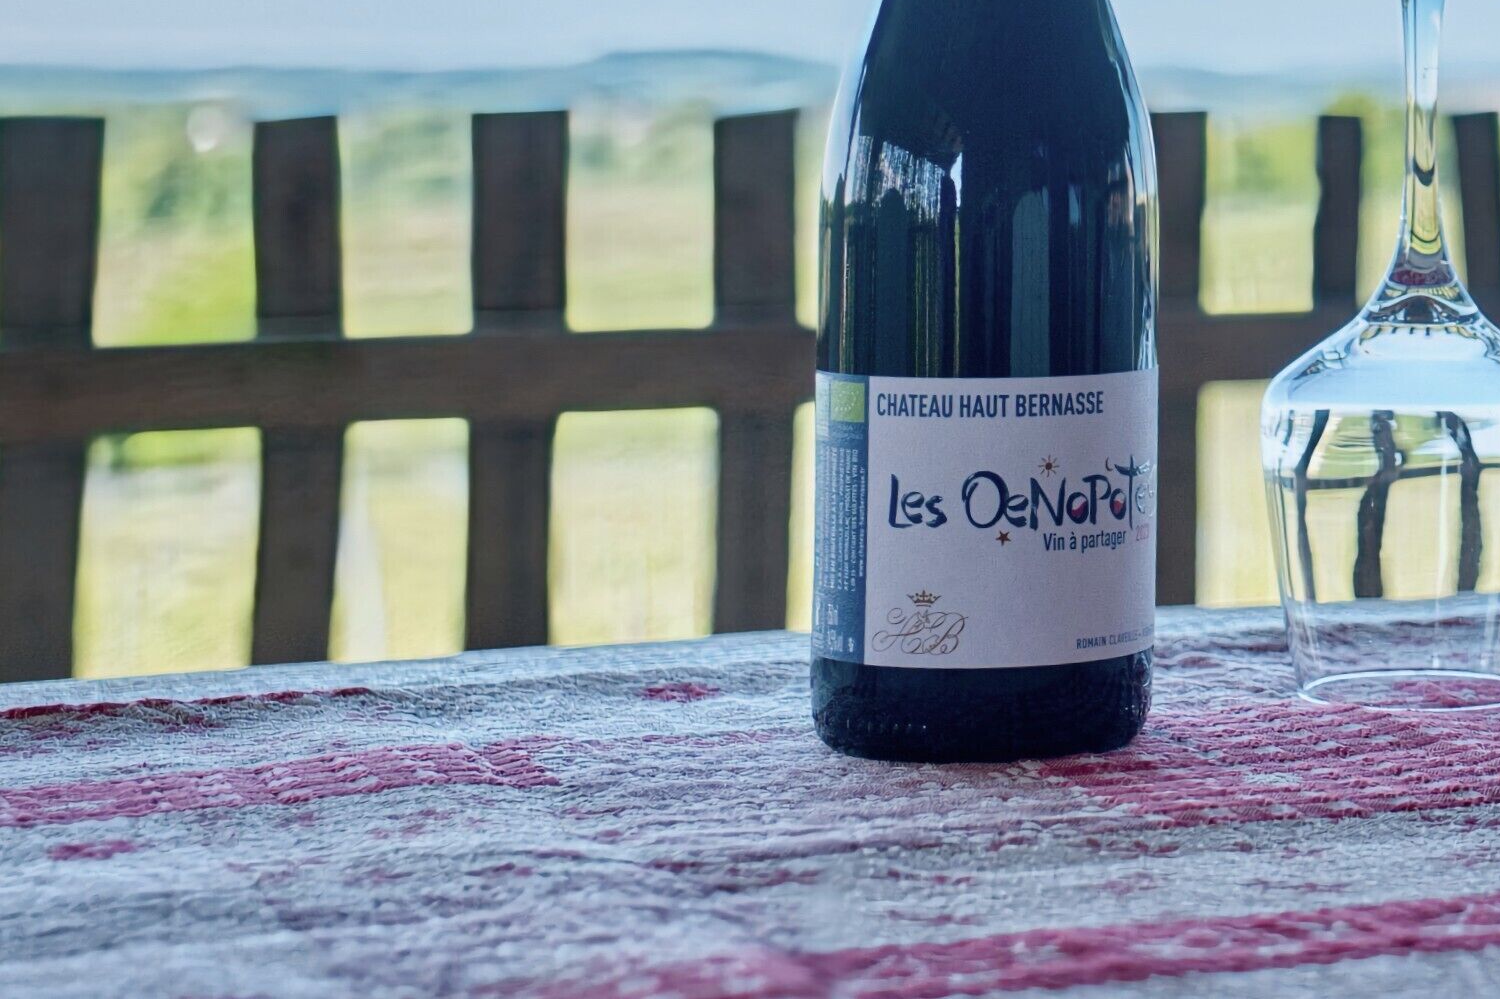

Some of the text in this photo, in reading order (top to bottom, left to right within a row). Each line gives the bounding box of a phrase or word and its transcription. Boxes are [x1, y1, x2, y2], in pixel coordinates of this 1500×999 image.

[877, 390, 1104, 418] CHATEAU HAUT BERNASSE
[889, 473, 948, 529] Les
[1043, 532, 1065, 551] Vin
[1069, 531, 1077, 550] à
[1081, 530, 1127, 554] partager
[1076, 636, 1107, 650] ROMAIN
